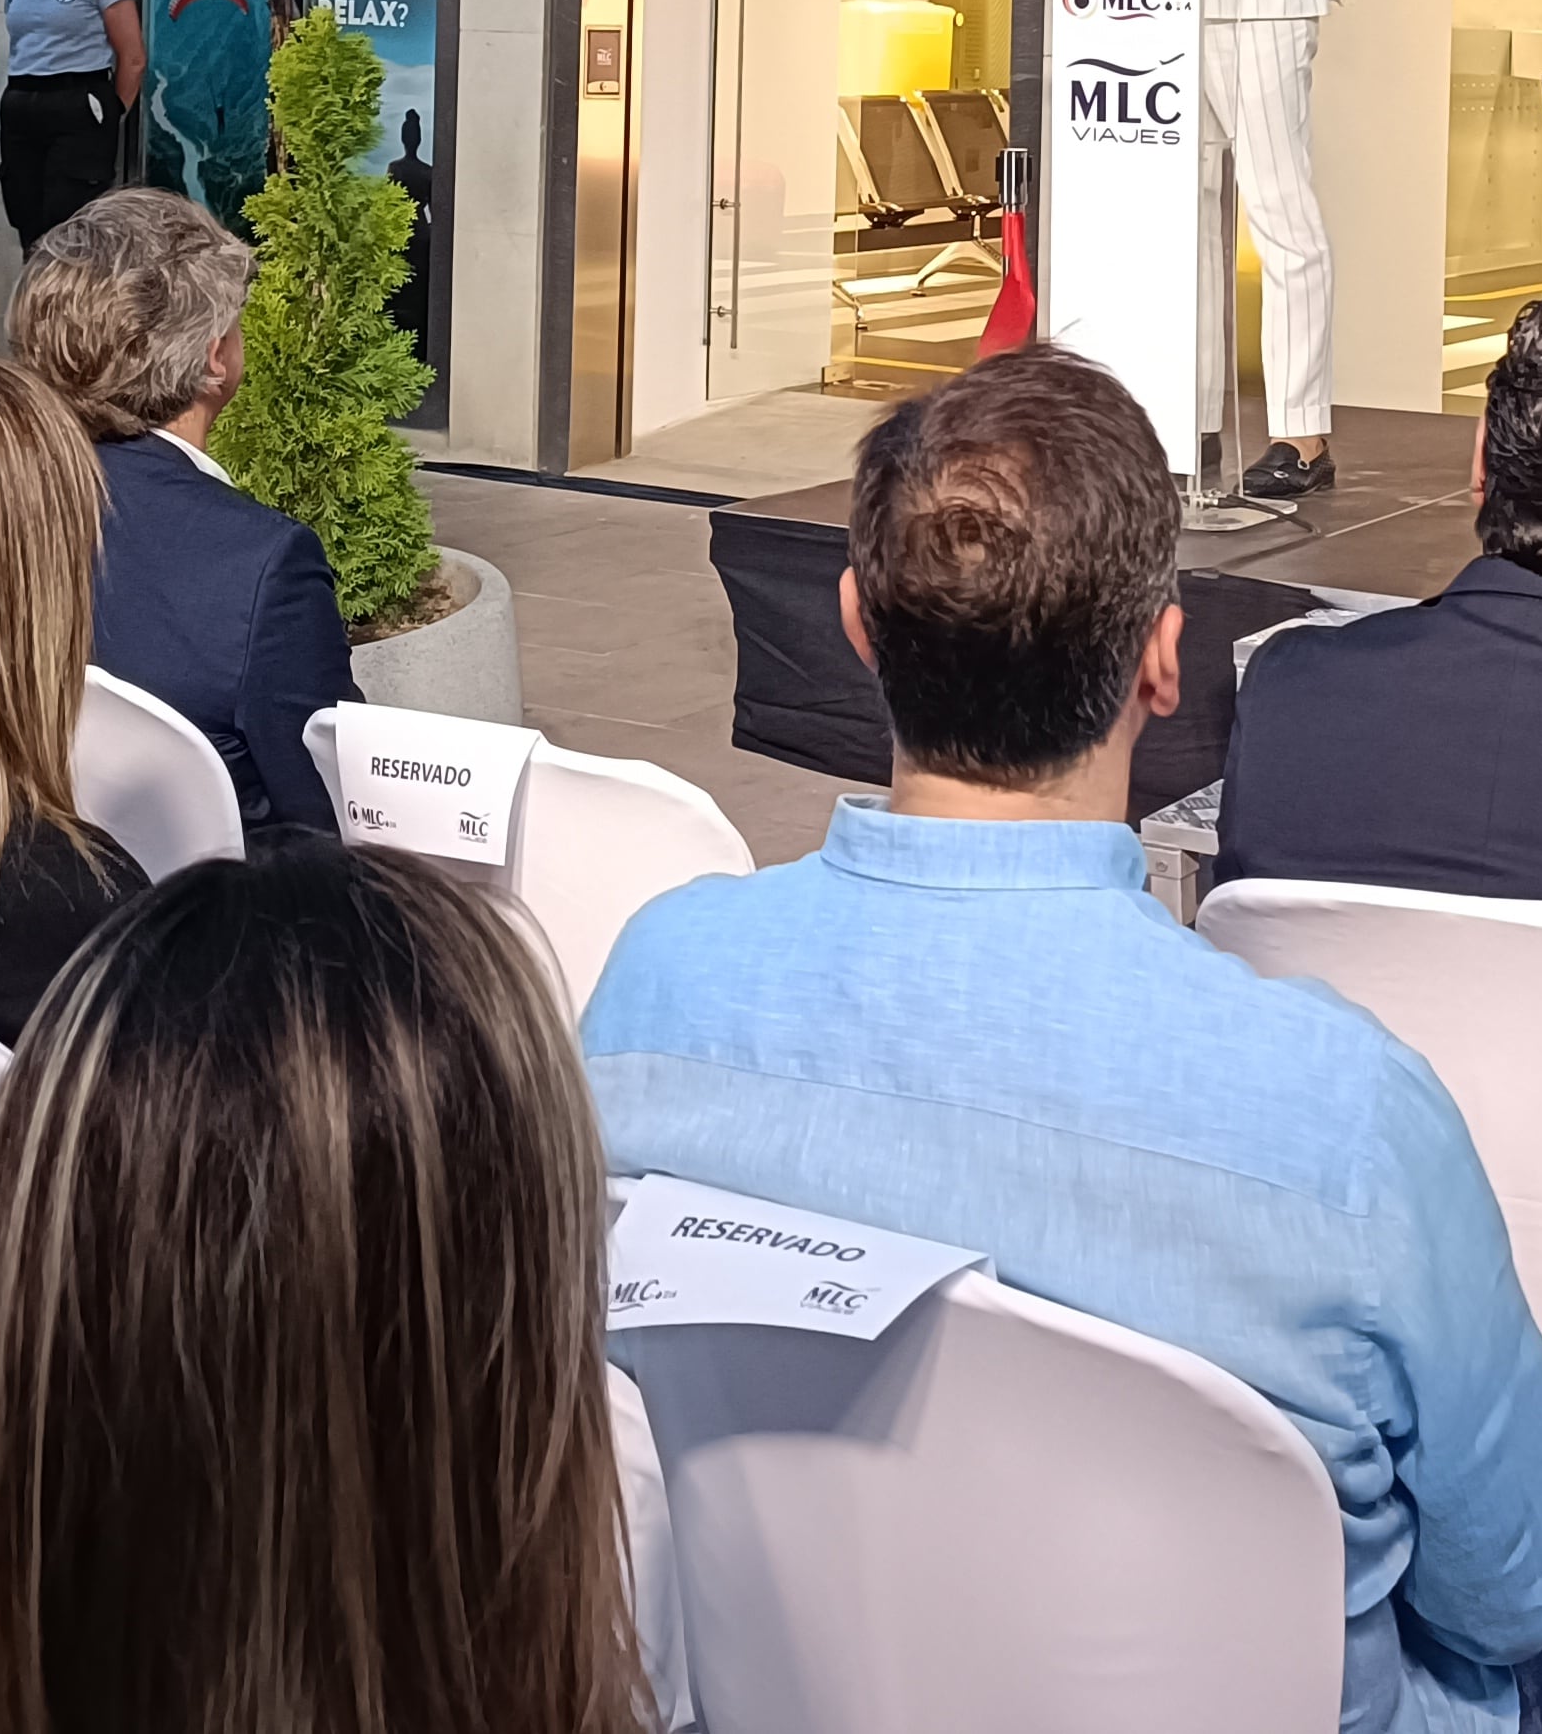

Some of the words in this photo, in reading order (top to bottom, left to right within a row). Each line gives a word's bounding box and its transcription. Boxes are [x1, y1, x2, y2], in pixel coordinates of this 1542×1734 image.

[1070, 80, 1182, 125] MLC
[1071, 126, 1181, 145] VIAJES
[370, 756, 472, 787] RESERVADO
[361, 807, 385, 826] MLC
[459, 818, 489, 837] MLC
[670, 1216, 867, 1262] RESERVADO
[612, 1278, 660, 1303] MLC
[802, 1286, 868, 1309] MLC
